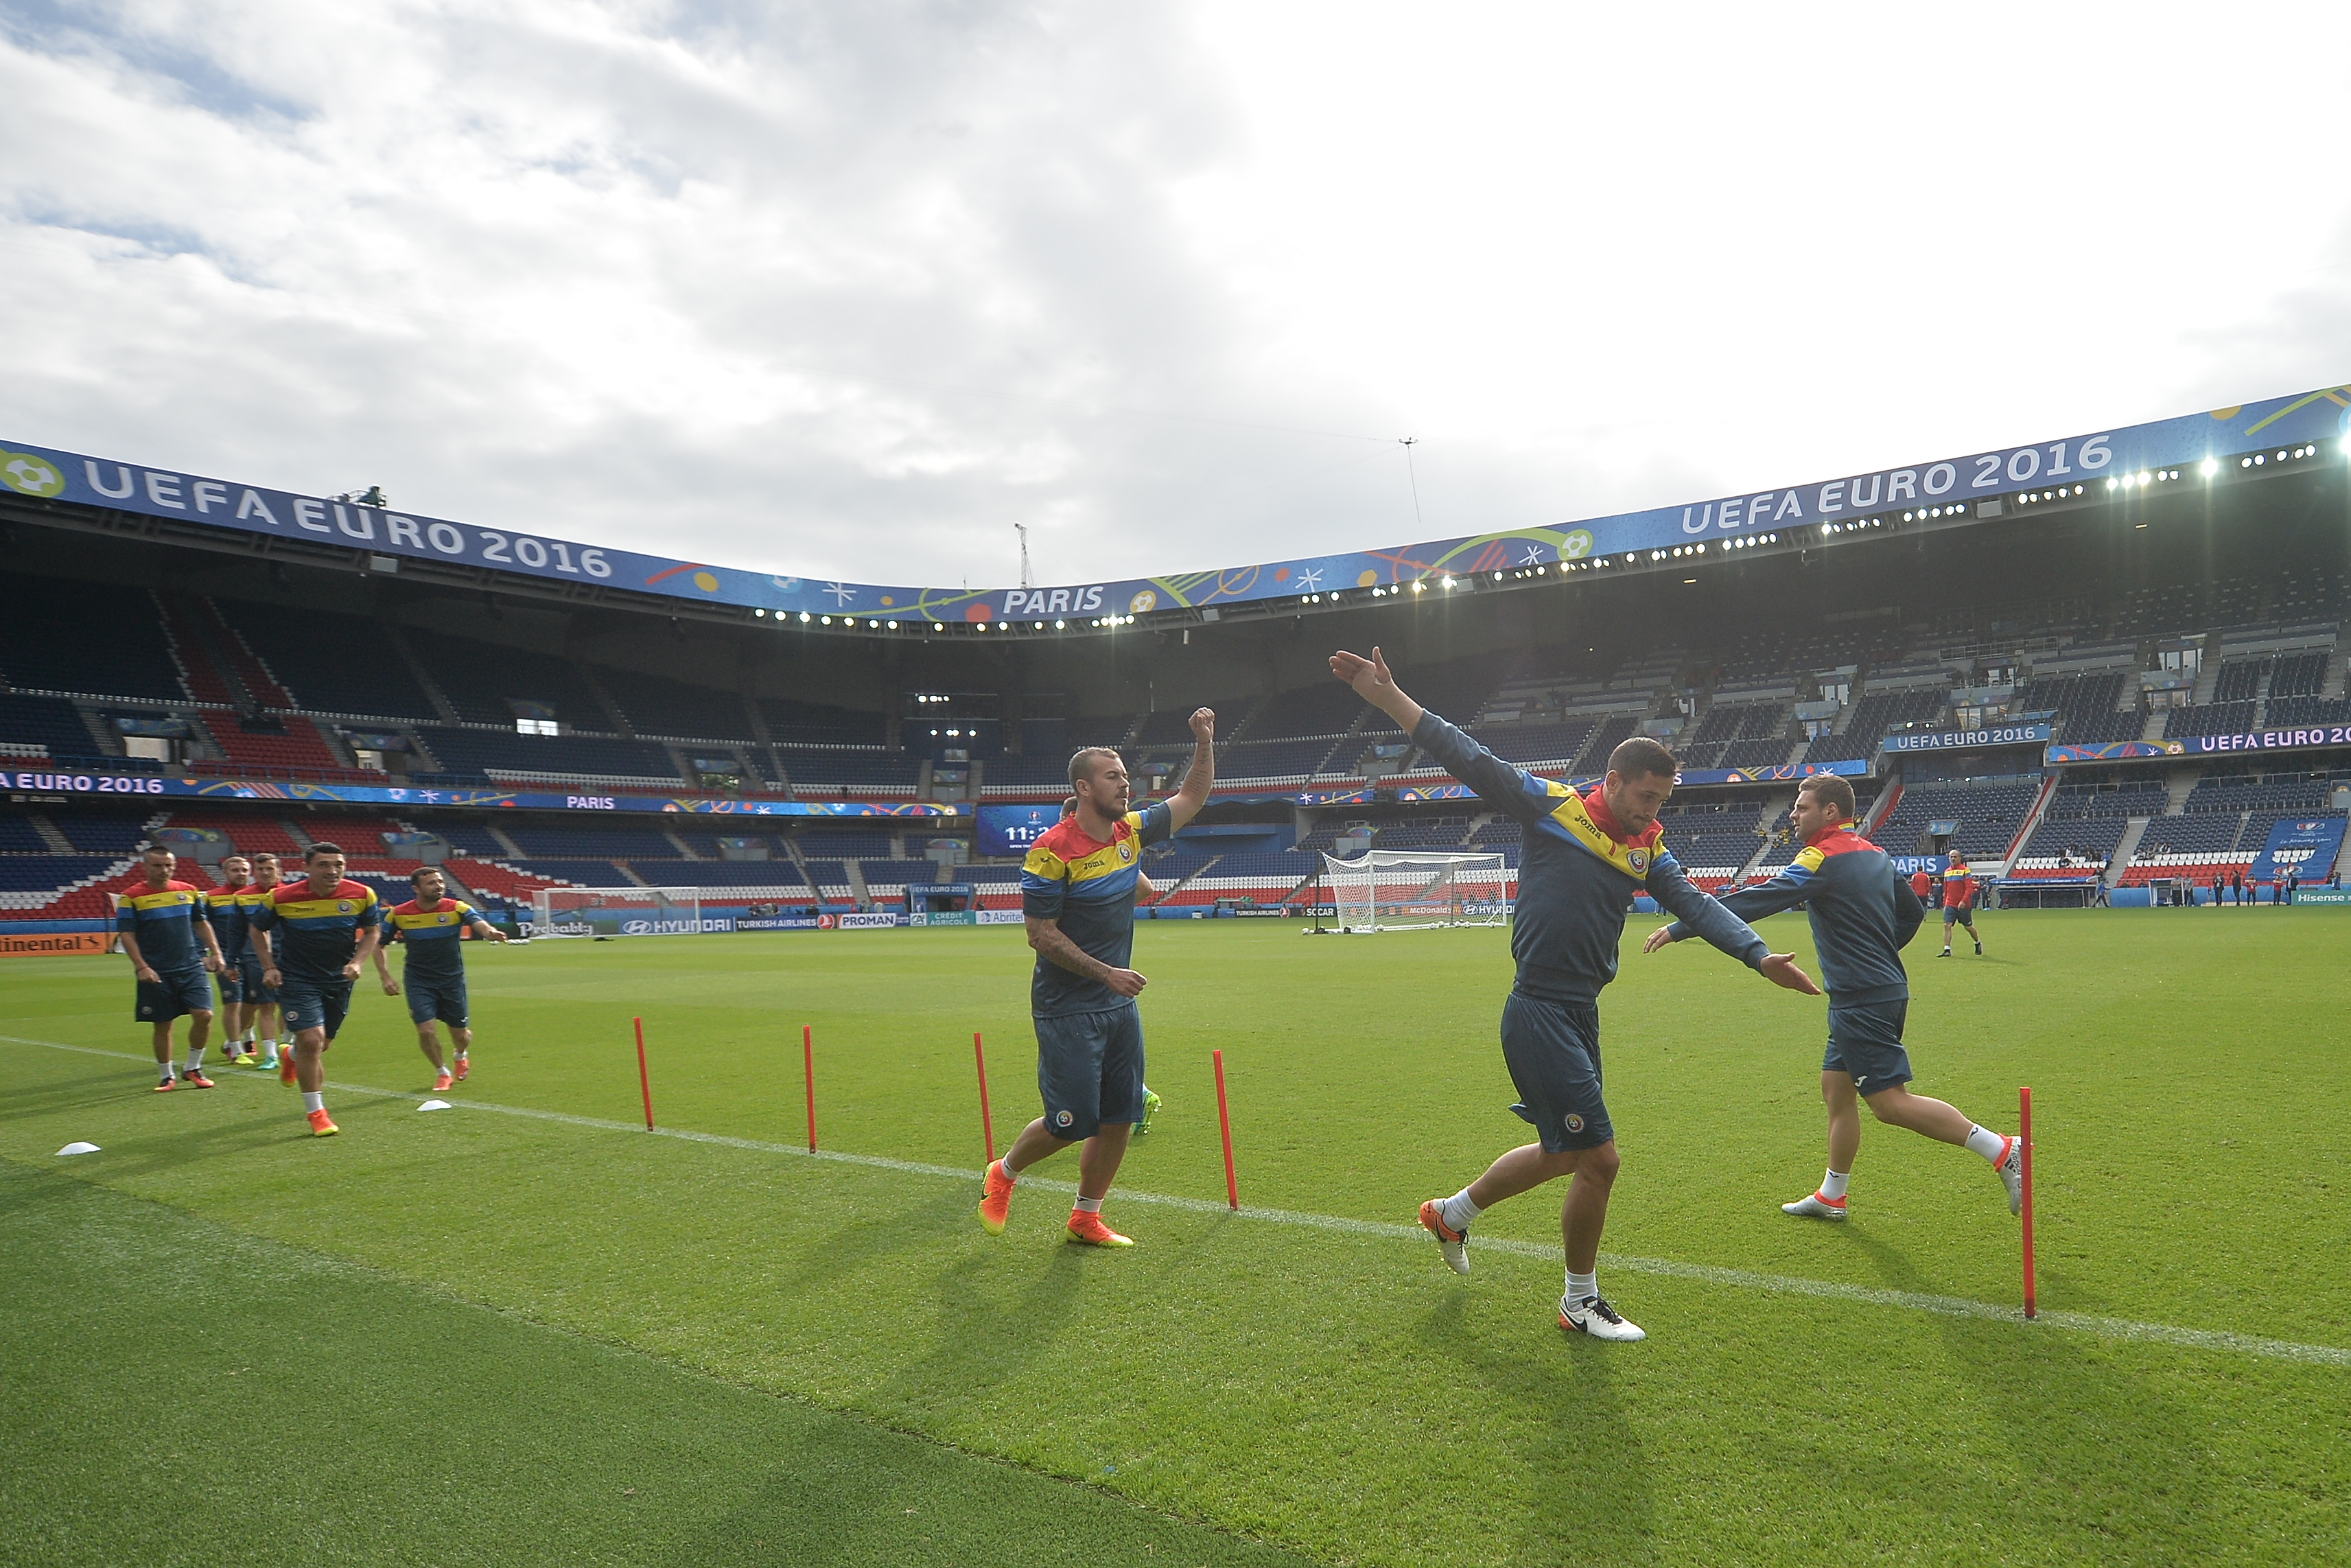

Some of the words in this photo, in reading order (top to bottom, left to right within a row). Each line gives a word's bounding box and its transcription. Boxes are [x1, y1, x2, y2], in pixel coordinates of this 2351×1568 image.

[1681, 489, 1803, 535] UEFA
[1818, 462, 1956, 513] EURO
[1972, 435, 2113, 489] 2016
[84, 460, 279, 526] UEFA
[293, 498, 465, 554] EURO
[482, 531, 613, 578] 2016
[1003, 585, 1103, 614] PARIS
[1897, 734, 1940, 749] UEFA
[1944, 731, 1988, 746] EURO
[1993, 727, 2035, 742] 2016
[2201, 734, 2258, 751] UEFA
[2264, 729, 2324, 747] EURO
[2330, 727, 2351, 742] 20
[16, 773, 93, 791] EURO
[97, 776, 164, 794] 2016
[567, 796, 615, 810] PARIS
[1005, 826, 1049, 841] 11:2
[2298, 893, 2346, 902] Hisense
[993, 912, 1023, 923] Abritel
[1306, 908, 1334, 917] SOCAR
[654, 919, 730, 933] HYUNDAI
[736, 920, 776, 928] TURKISH
[778, 918, 816, 927] AIRLINES
[843, 915, 893, 926] PROMAN
[517, 922, 594, 936] Probably
[0, 936, 80, 952] inental
